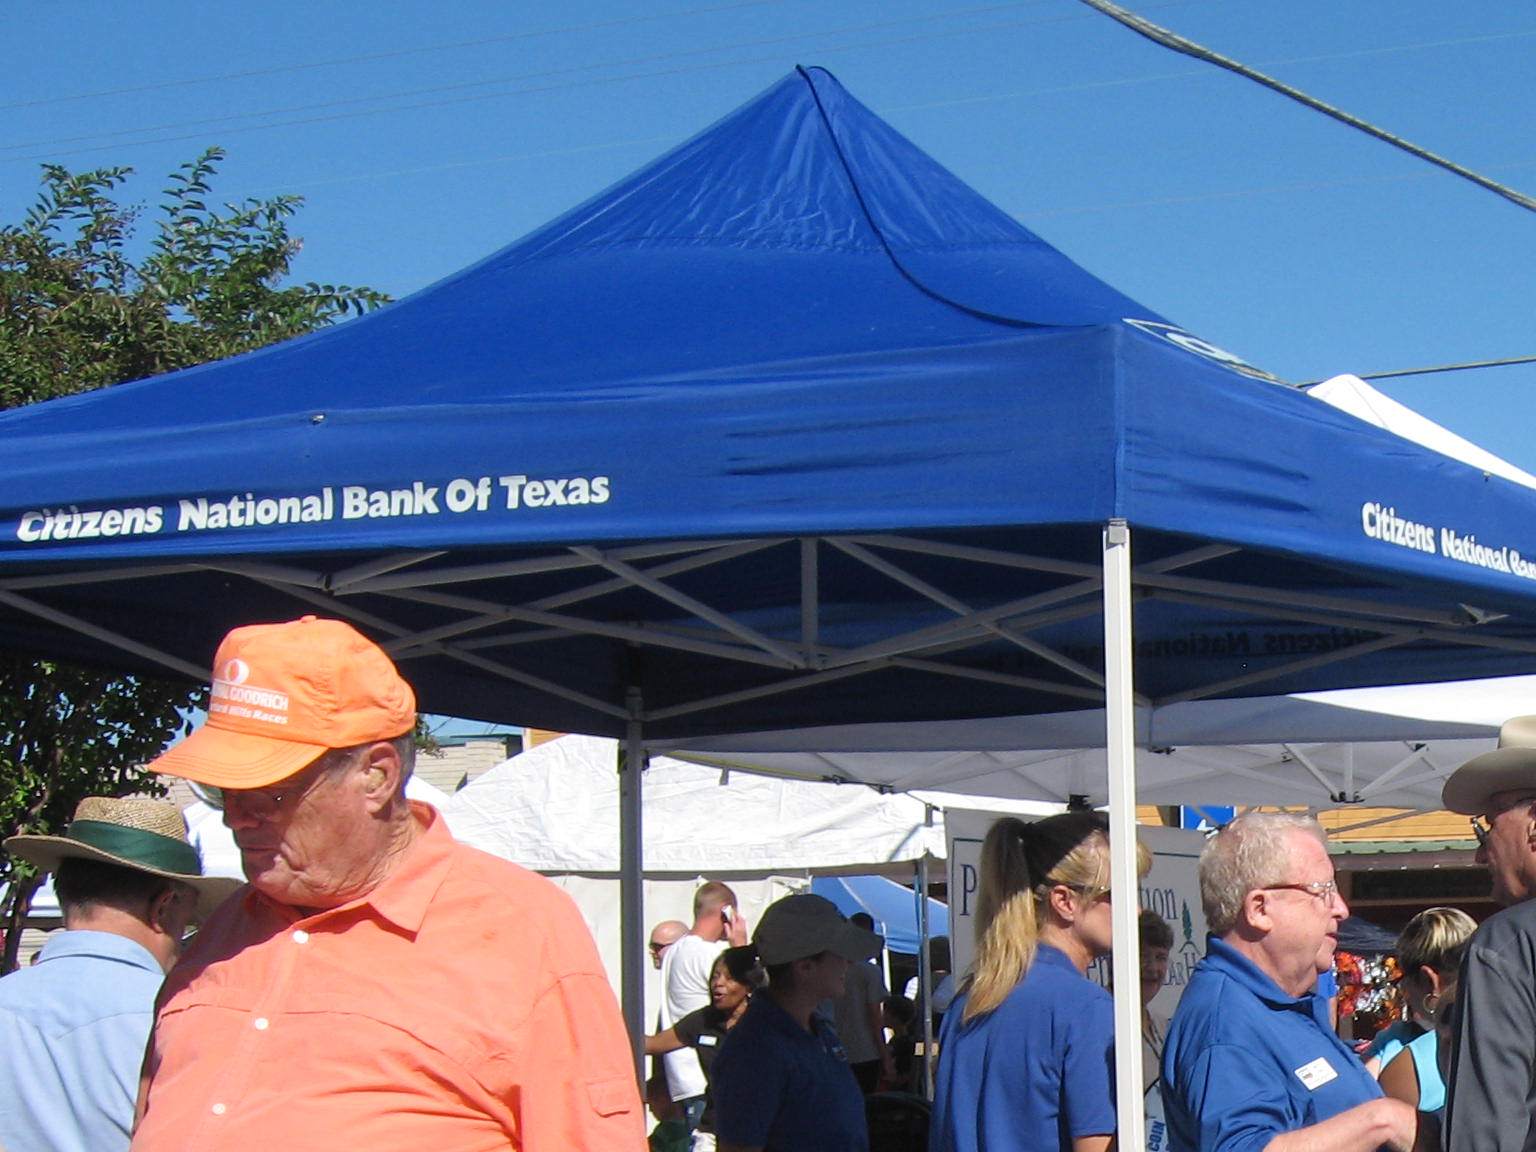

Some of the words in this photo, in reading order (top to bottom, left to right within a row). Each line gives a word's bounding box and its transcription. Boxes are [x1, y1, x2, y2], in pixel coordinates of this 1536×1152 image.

[16, 505, 164, 543] Citizens
[178, 487, 333, 531] National
[342, 482, 440, 519] Bank
[446, 477, 491, 513] Of
[500, 475, 610, 509] Texas
[1361, 502, 1436, 554] Citizens
[1440, 527, 1512, 574] National
[229, 686, 289, 711] GOODRICH
[1147, 1120, 1166, 1152] COIN
